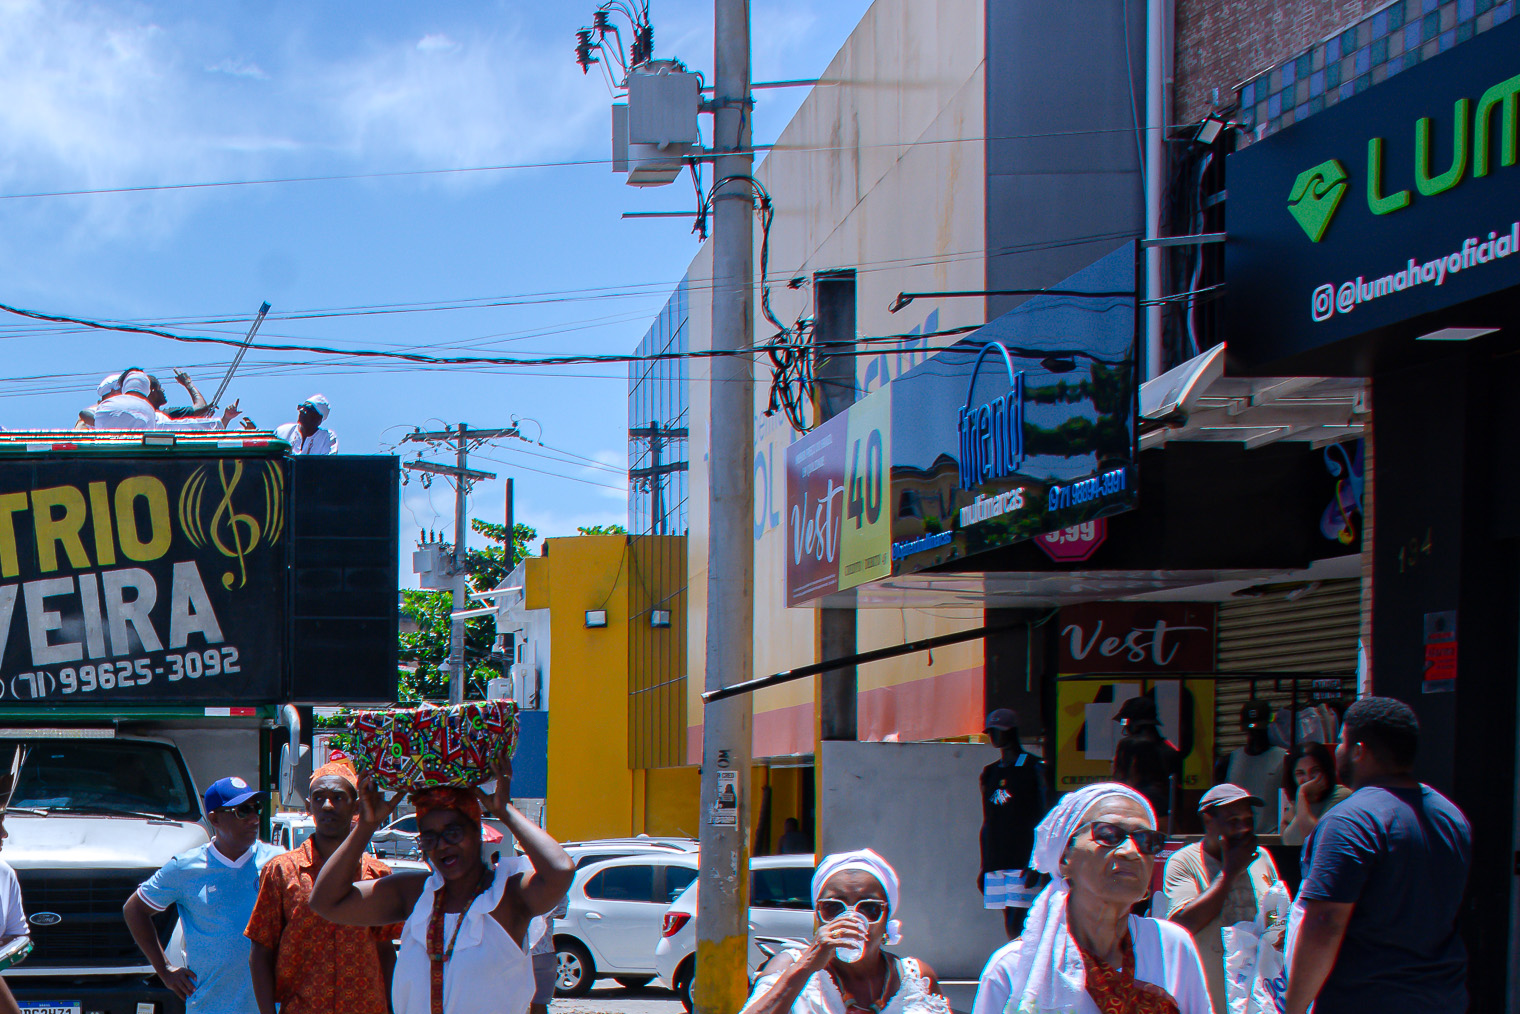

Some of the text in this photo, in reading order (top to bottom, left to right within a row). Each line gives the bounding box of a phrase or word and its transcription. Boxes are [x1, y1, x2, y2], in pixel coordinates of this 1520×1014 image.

[1336, 221, 1520, 314] @lumahayoficial
[846, 429, 882, 529] 40
[960, 486, 1026, 528] multimarcas
[791, 479, 845, 565] Vest
[11, 646, 241, 699] (71) 99625-3092
[1061, 620, 1208, 666] Vest
